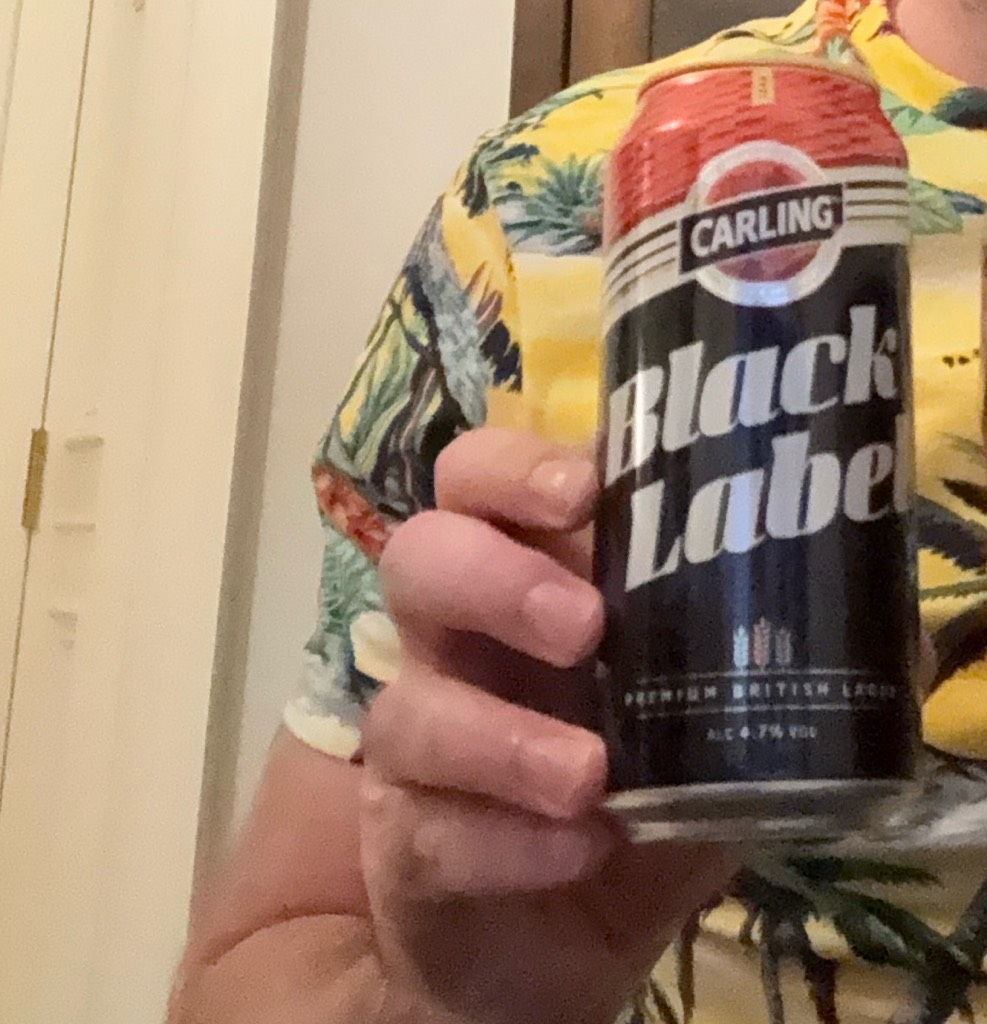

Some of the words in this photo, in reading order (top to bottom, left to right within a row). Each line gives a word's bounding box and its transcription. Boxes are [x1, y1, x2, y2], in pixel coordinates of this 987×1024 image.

[690, 195, 833, 257] CARLING
[605, 304, 898, 489] Black
[624, 685, 717, 706] PREMIUM
[732, 681, 829, 699] BRITISH
